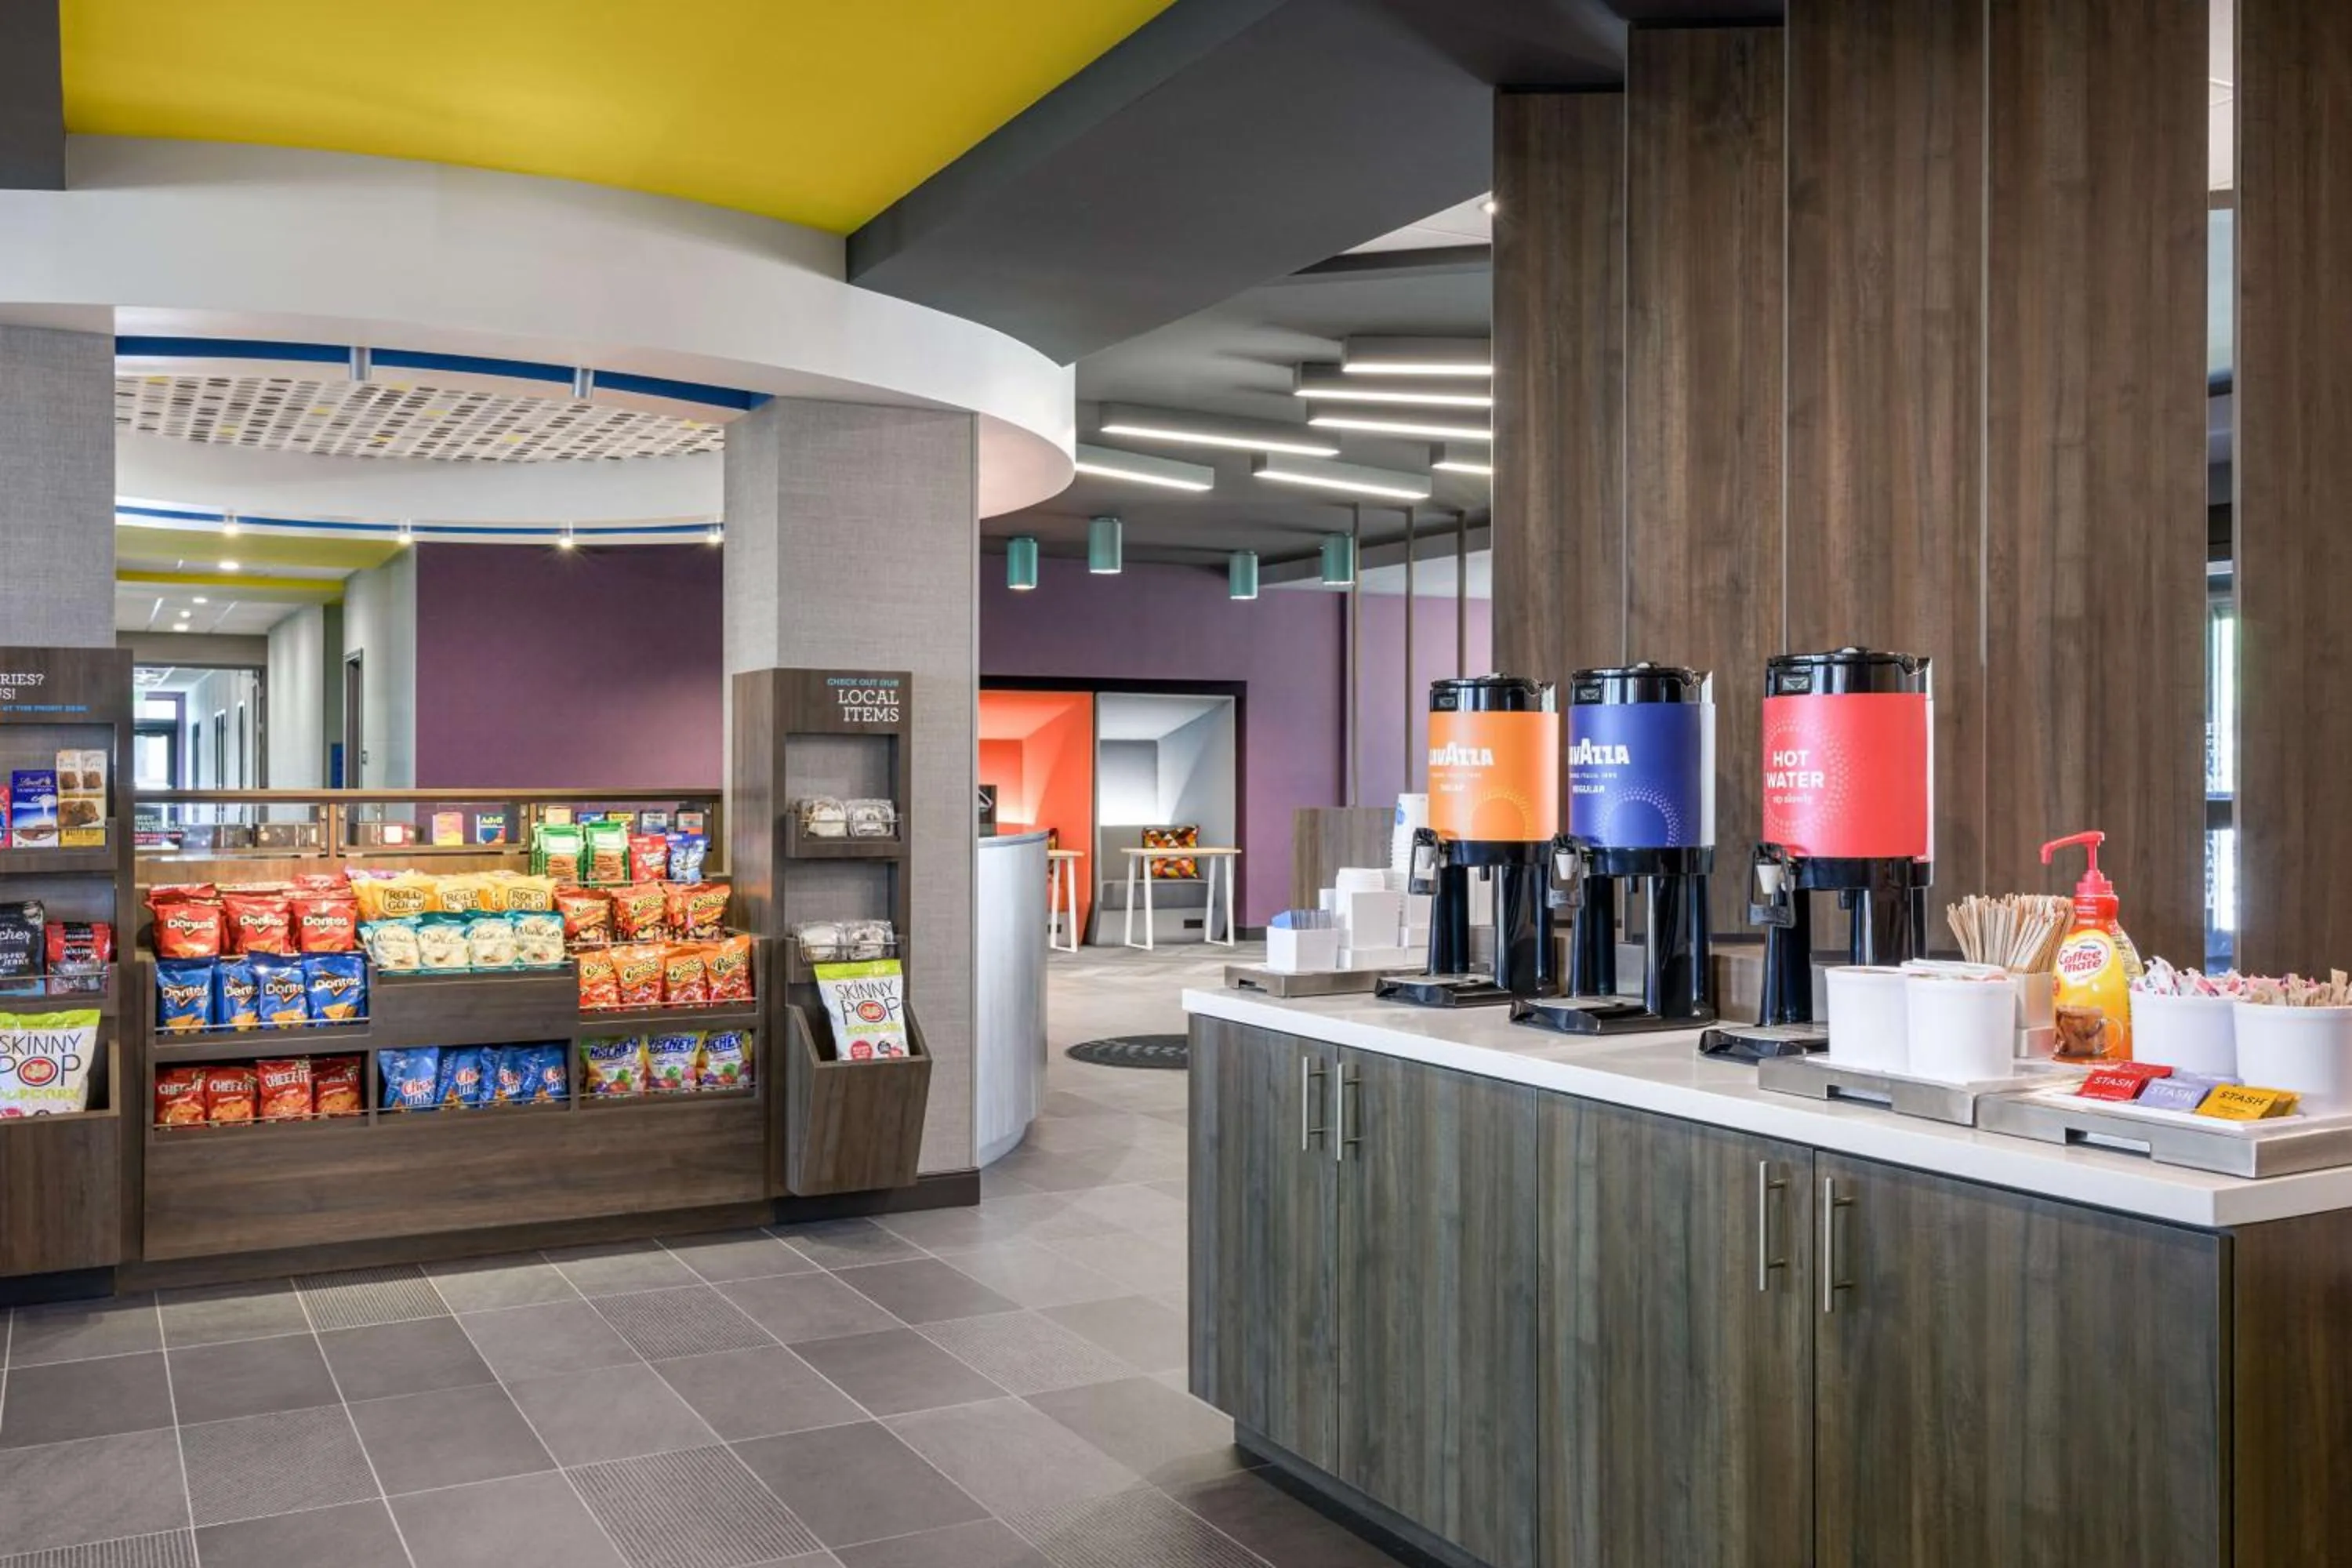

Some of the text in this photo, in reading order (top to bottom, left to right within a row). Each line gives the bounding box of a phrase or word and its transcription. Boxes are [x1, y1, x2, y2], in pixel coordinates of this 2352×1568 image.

[0, 673, 45, 686] RIES?
[858, 678, 877, 687] OUT
[0, 688, 16, 700] S!
[837, 689, 900, 705] LOCAL
[843, 706, 900, 722] ITEMS
[1429, 741, 1494, 766] VAZZA
[1568, 738, 1630, 765] VAZZA
[1773, 750, 1810, 768] HOT
[1766, 771, 1824, 789] WATER
[2059, 949, 2103, 966] Coffee
[2063, 959, 2103, 973] mate
[835, 979, 894, 1000] SKINNY
[840, 996, 901, 1025] POP
[0, 1033, 82, 1055] SKINNY
[2094, 1076, 2136, 1089] STASH
[2151, 1085, 2196, 1104] STASH
[2219, 1091, 2266, 1106] STASH
